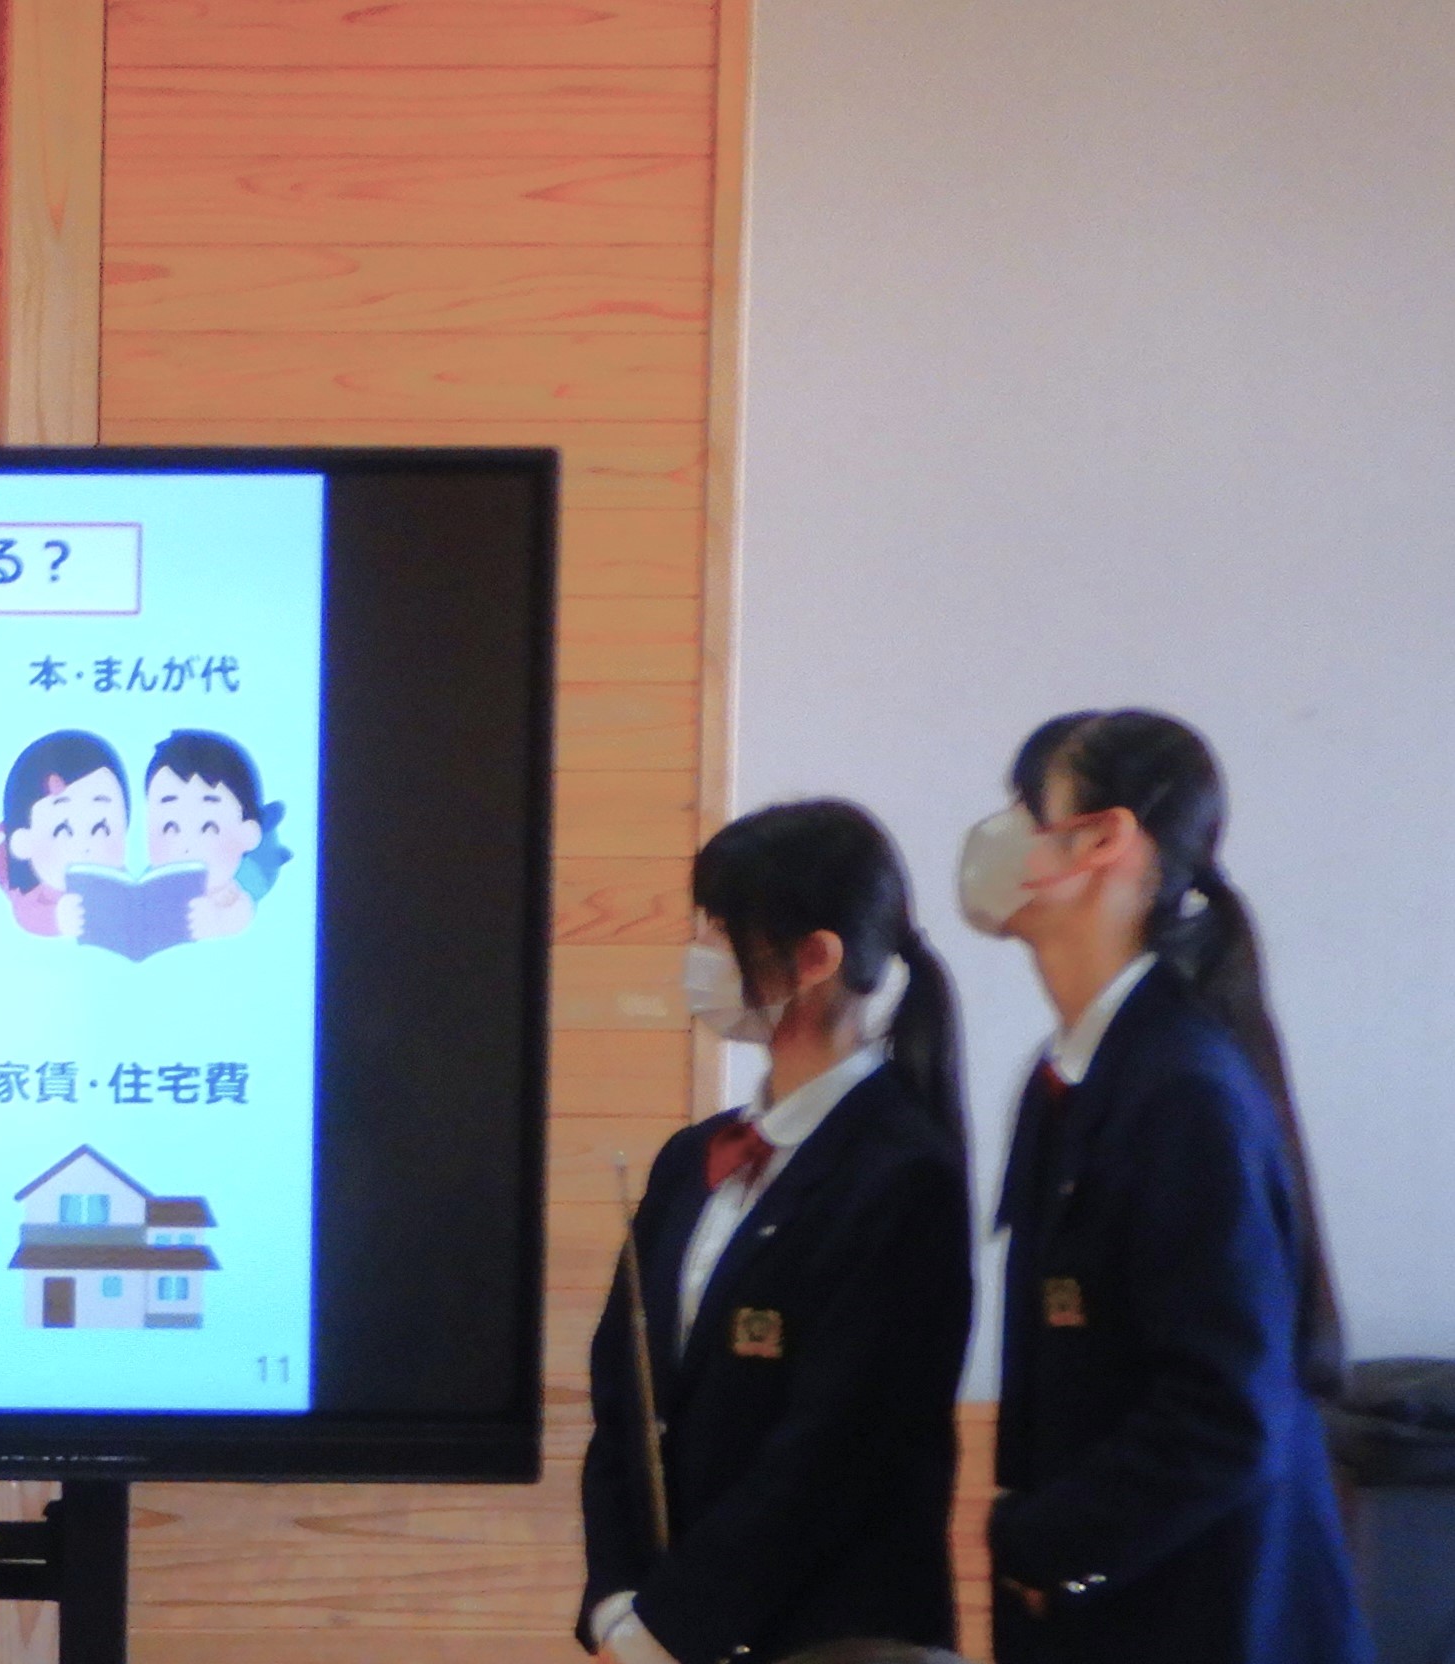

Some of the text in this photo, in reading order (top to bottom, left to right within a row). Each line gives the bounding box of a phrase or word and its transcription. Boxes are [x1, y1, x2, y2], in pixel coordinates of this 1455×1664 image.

[29, 654, 240, 694] 本・まんが代
[256, 1355, 292, 1384] 11
